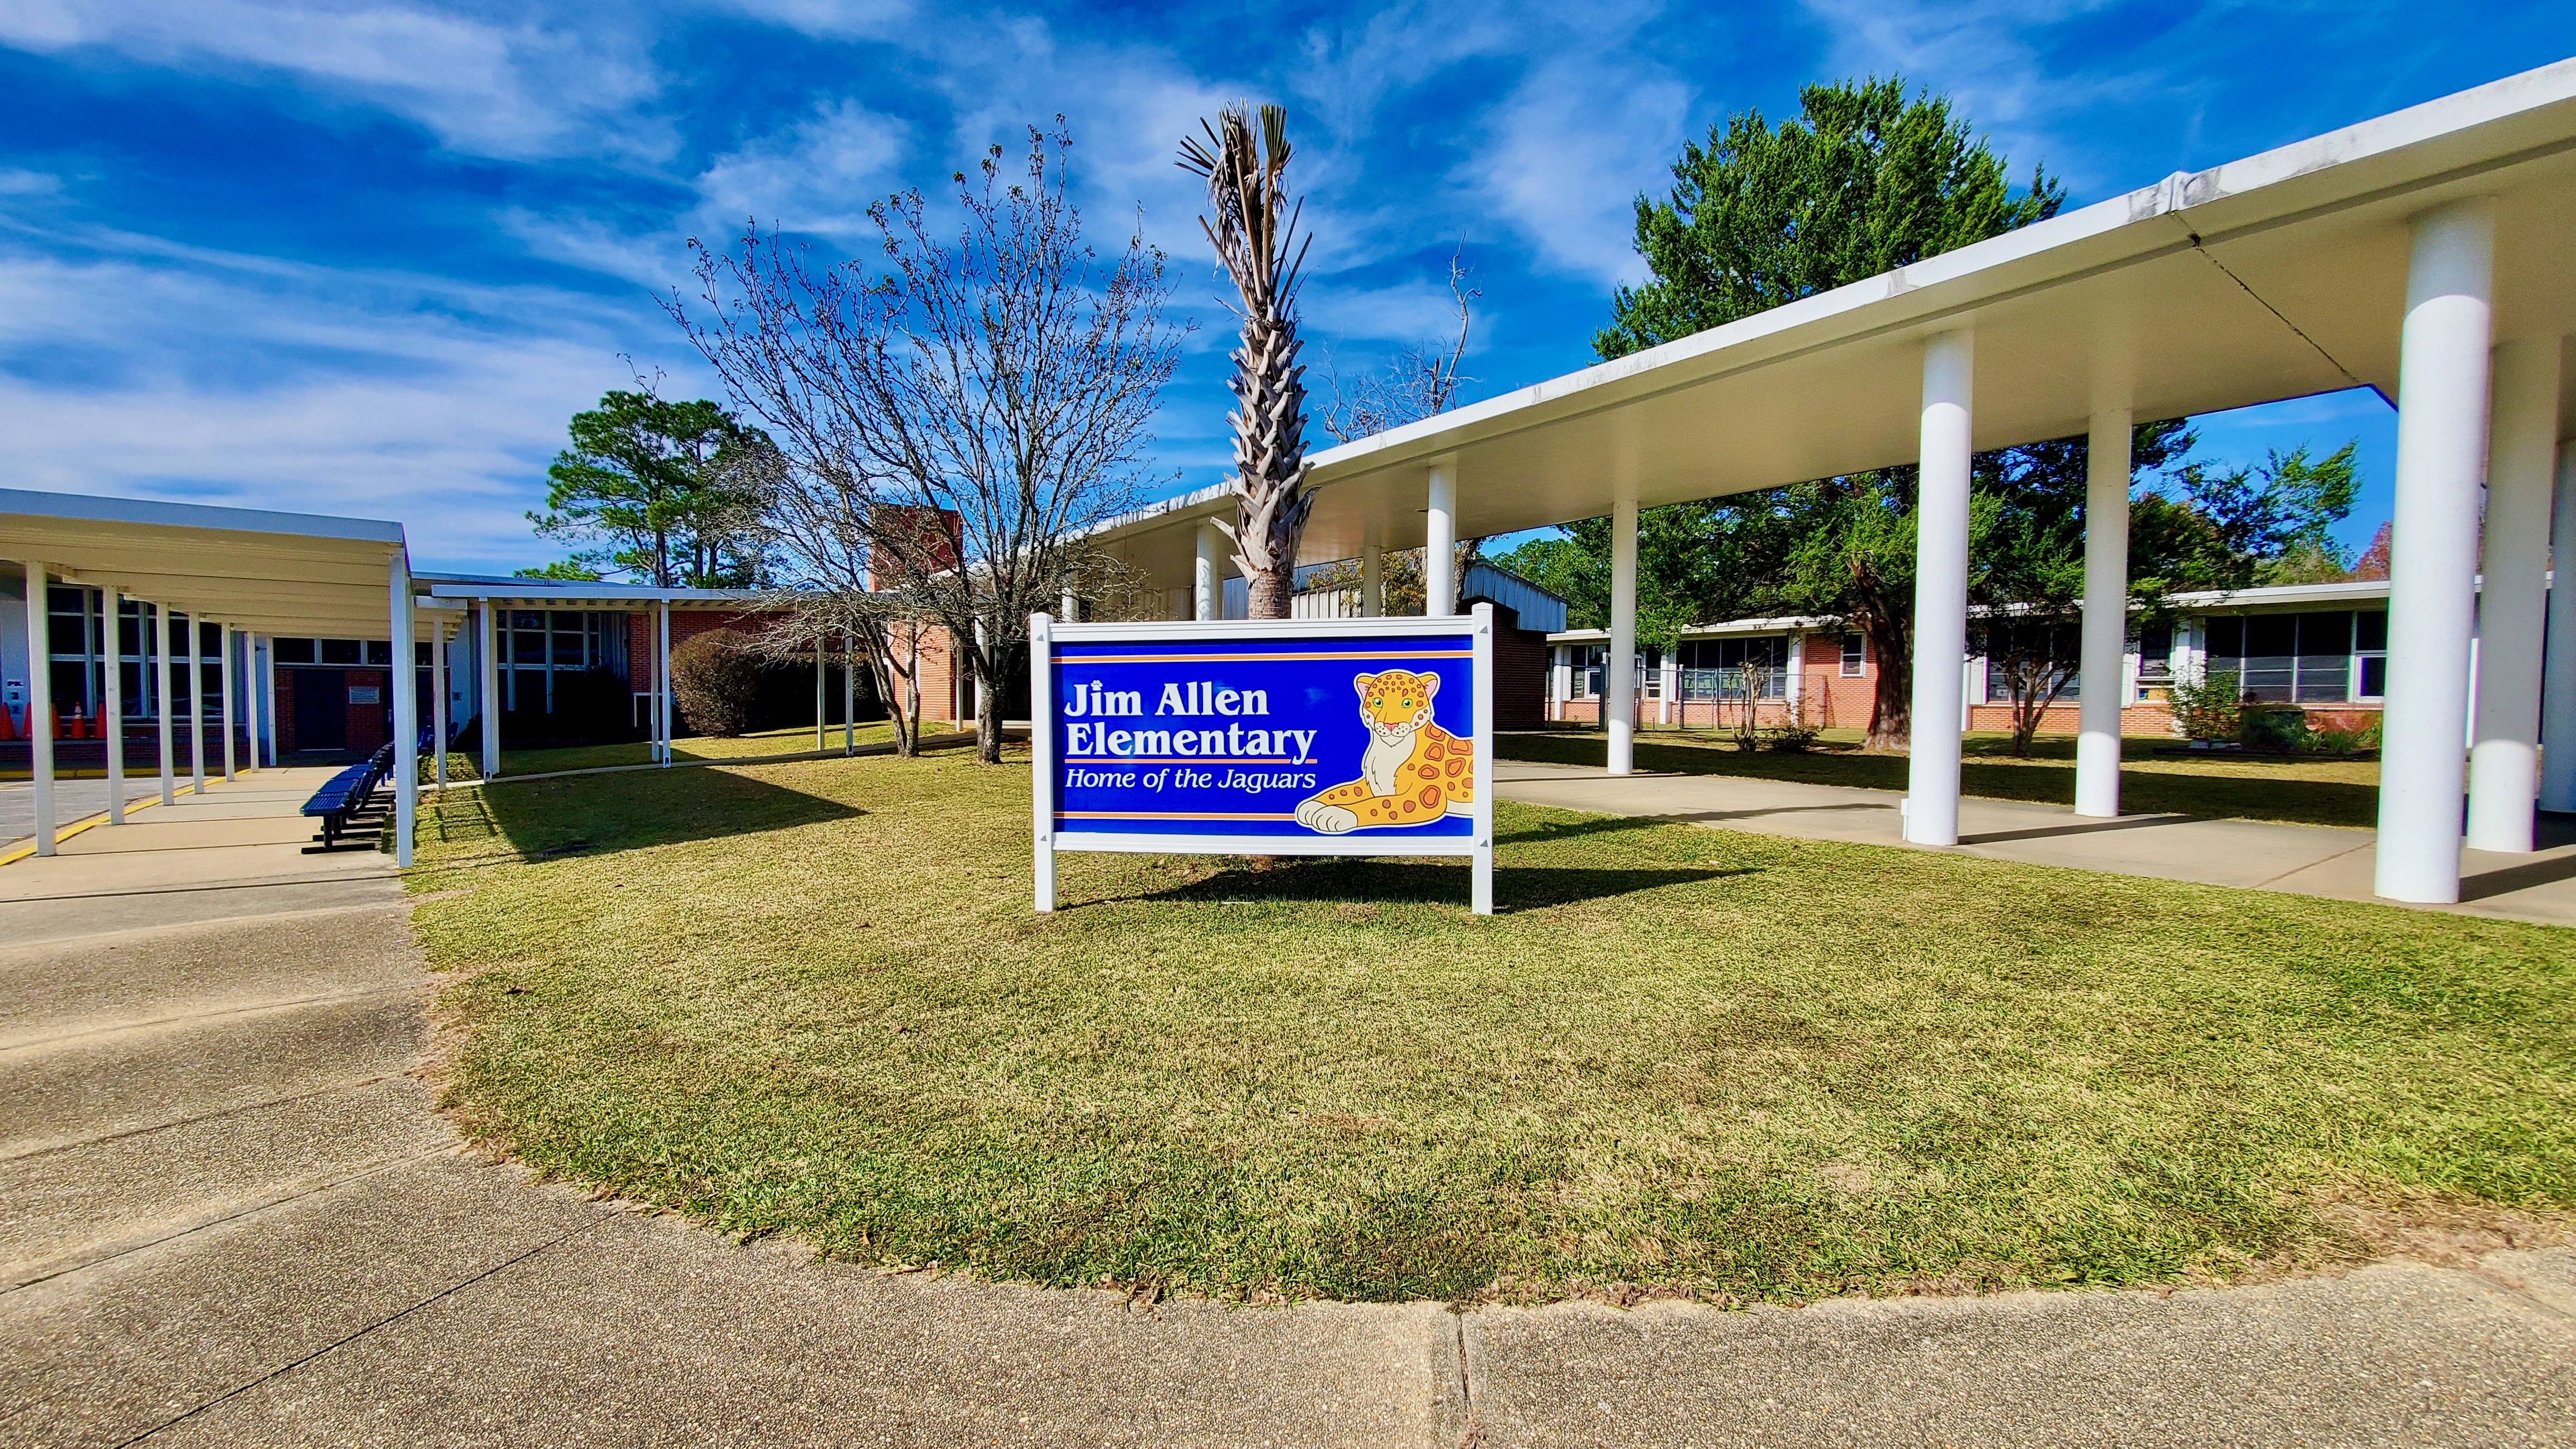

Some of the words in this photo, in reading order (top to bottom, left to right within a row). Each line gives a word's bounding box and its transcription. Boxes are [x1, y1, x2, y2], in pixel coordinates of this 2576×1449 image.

[1064, 680, 1143, 717] Jim
[1154, 681, 1270, 716] Allen
[1066, 721, 1318, 765] Elementary
[1064, 768, 1136, 788] Home
[1143, 768, 1171, 793] of
[1175, 768, 1212, 788] the
[1217, 769, 1316, 794] Jaguars
